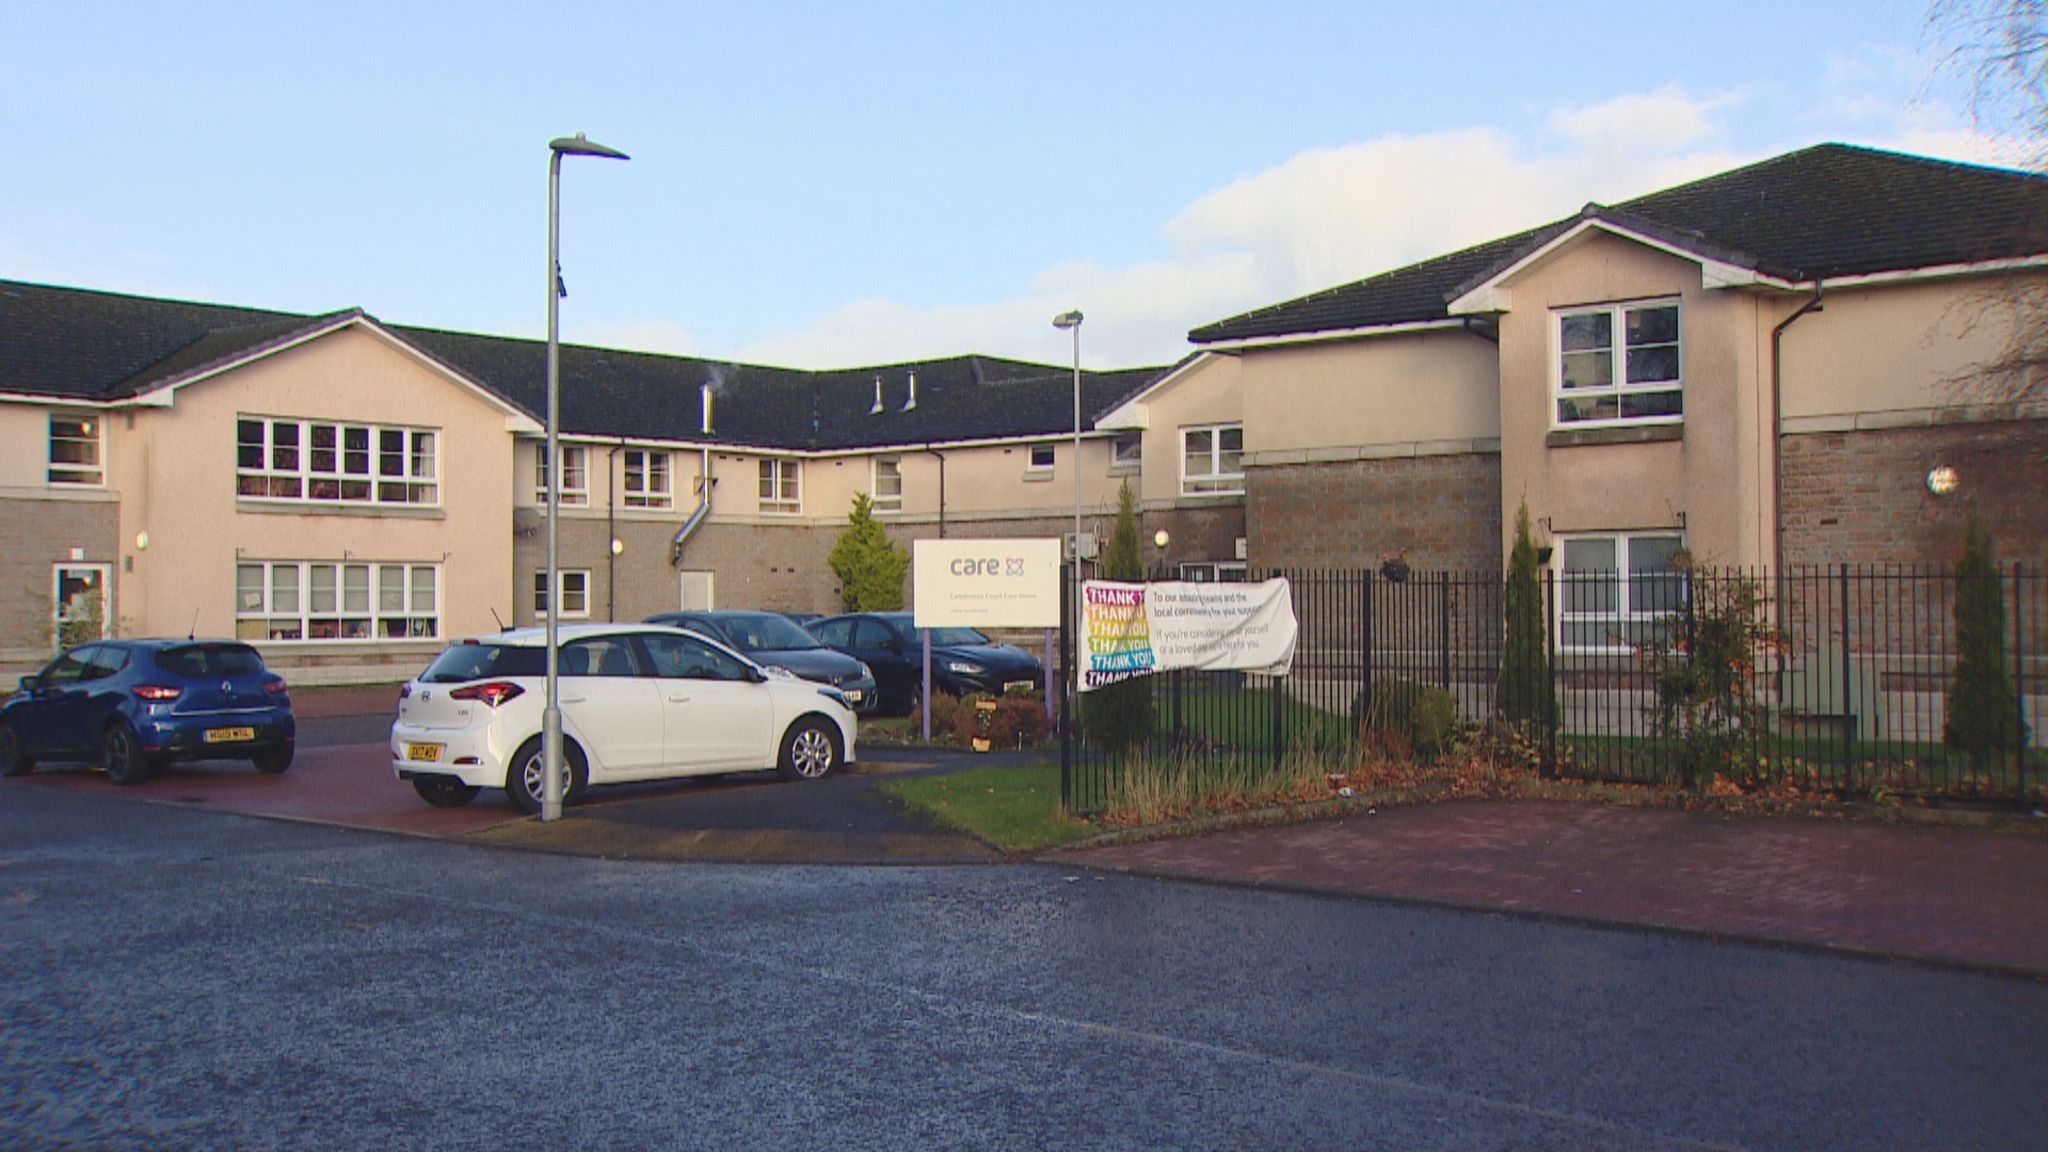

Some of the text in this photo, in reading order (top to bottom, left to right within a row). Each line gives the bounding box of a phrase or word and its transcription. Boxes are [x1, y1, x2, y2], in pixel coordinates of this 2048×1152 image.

[950, 558, 1000, 576] care
[1090, 589, 1136, 606] THANK
[1153, 592, 1164, 602] To
[1154, 606, 1173, 617] local
[1094, 653, 1132, 672] THANK
[1132, 650, 1154, 667] YOU
